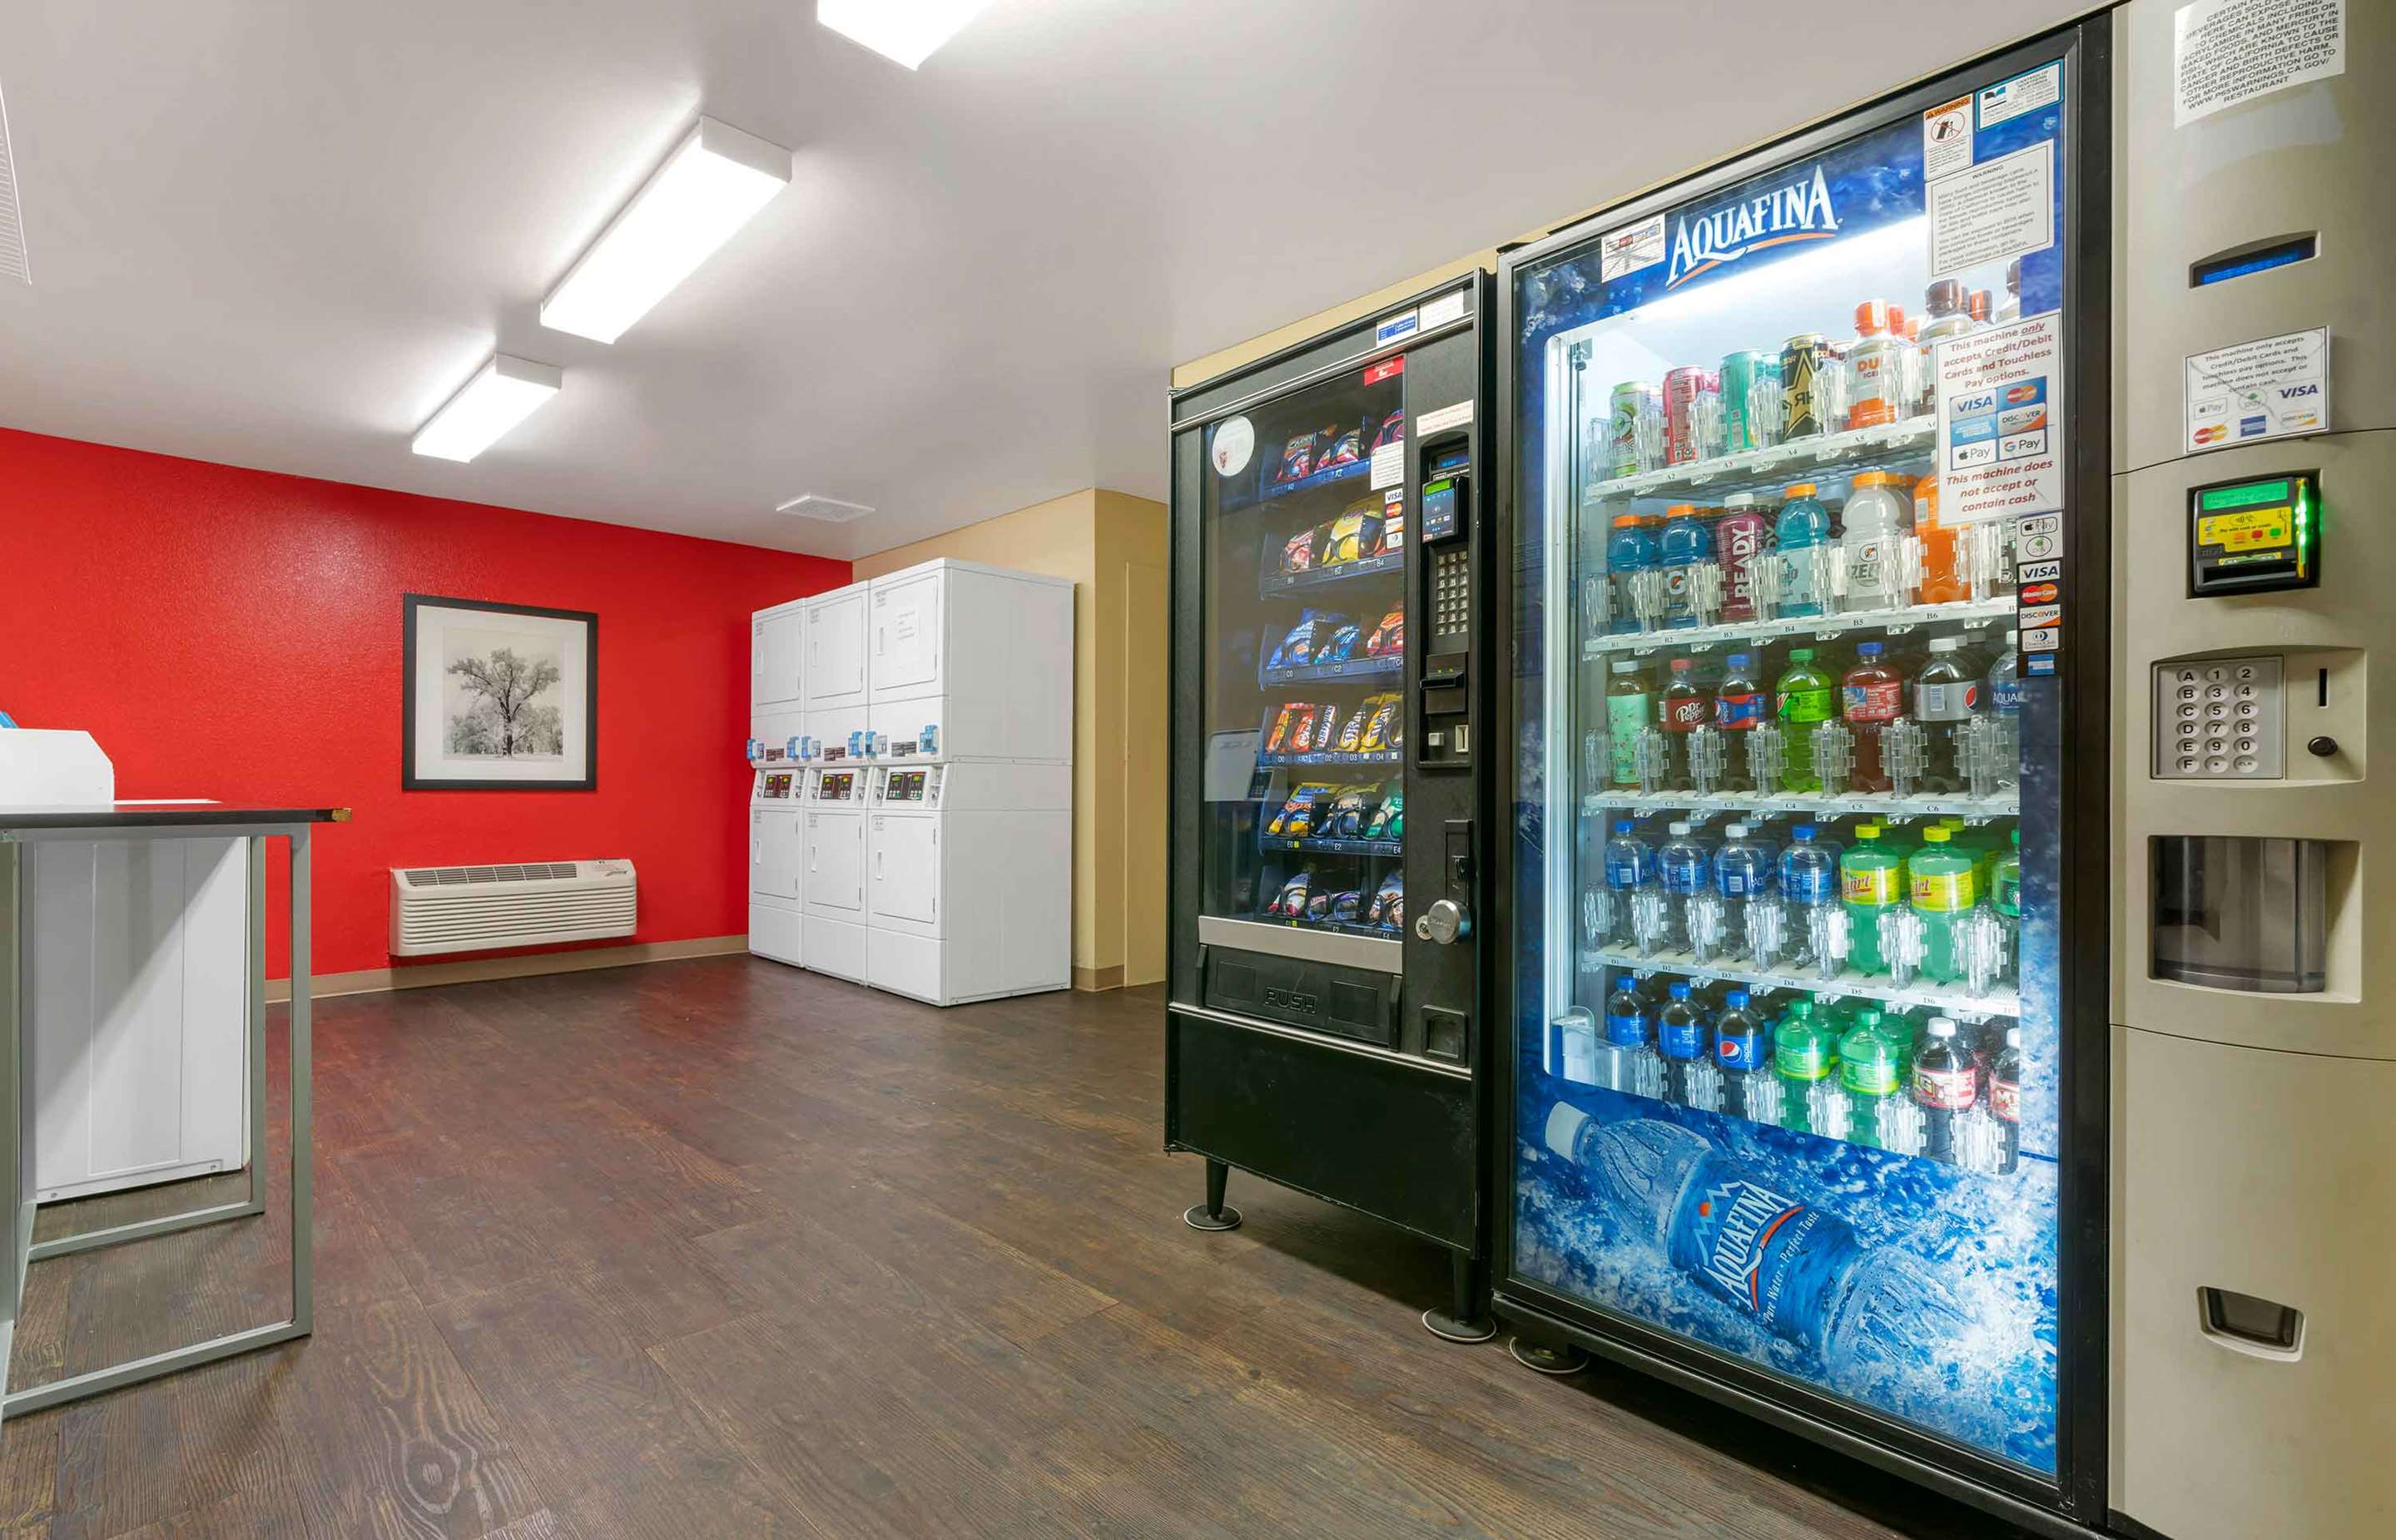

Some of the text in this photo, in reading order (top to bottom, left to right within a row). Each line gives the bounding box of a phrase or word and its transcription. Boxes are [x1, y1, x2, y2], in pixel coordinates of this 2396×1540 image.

[2200, 0, 2290, 38] HERE CAN EXPOSE
[2245, 0, 2270, 13] SOLD
[2183, 1, 2336, 62] ACRYLAMIDE IN MANY FRIED OR
[2209, 16, 2264, 42] CHEMICALS
[2267, 0, 2322, 19] INCLUDING
[2180, 52, 2210, 70] BAKED
[2252, 27, 2272, 40] AND
[2276, 12, 2325, 32] MERCURY
[2329, 8, 2338, 17] IN
[2205, 49, 2235, 67] WHICH
[2239, 40, 2258, 53] ARE
[2261, 27, 2299, 44] KNOWN
[2303, 22, 2315, 32] TO
[2319, 16, 2338, 27] THE
[2180, 24, 2337, 85] STATE OF CALIFORNIA TO CAUSE
[2180, 31, 2338, 92] CANCER AND BIRTH DEFECTS OR
[2183, 47, 2335, 105] FOR MORE INFORMATION GO TO
[2186, 77, 2216, 97] OTHER
[2220, 50, 2295, 82] REPRODUCTIVE
[2223, 74, 2289, 103] RESTAURANT
[1666, 165, 1838, 285] AQUAFINA
[1951, 320, 2045, 351] This machine only
[2205, 335, 2304, 361] This machine only accepts
[1943, 332, 2052, 367] accepts Credit/Debit
[2210, 346, 2298, 370] Credit/Debit Cards and
[1944, 346, 2051, 379] Cards and Touchless
[2235, 373, 2253, 383] does
[2255, 370, 2269, 379] not
[2271, 364, 2296, 375] accept
[2239, 364, 2252, 374] pay
[2291, 354, 2307, 362] This
[1965, 364, 2029, 388] Pay options.
[2278, 384, 2319, 399] VISA
[1957, 397, 1992, 413] VISA
[1970, 448, 1991, 458] Pay
[2019, 439, 2041, 449] Pay
[1947, 458, 2052, 485] This machine does
[1387, 492, 1402, 501] VISA
[1959, 478, 2037, 498] not accept or
[1962, 492, 2036, 513] contain cash
[1732, 525, 1753, 597] READY
[2024, 566, 2058, 579] VISA
[2021, 610, 2058, 620] DISCOVER
[2184, 669, 2250, 681] A 1 2
[2184, 686, 2250, 698] B 3 4
[1689, 702, 1701, 712] Dr
[2184, 705, 2250, 716] C 5 6
[2184, 723, 2250, 733] D 7 8
[2184, 740, 2250, 750] E 9 0
[2184, 760, 2193, 769] F
[1264, 987, 1318, 1014] PUSH
[1704, 1180, 1799, 1310] AQUAFINA
[1767, 1273, 1784, 1302] Water
[1779, 1230, 1806, 1264] Perfect
[1799, 1211, 1820, 1233] Taste
